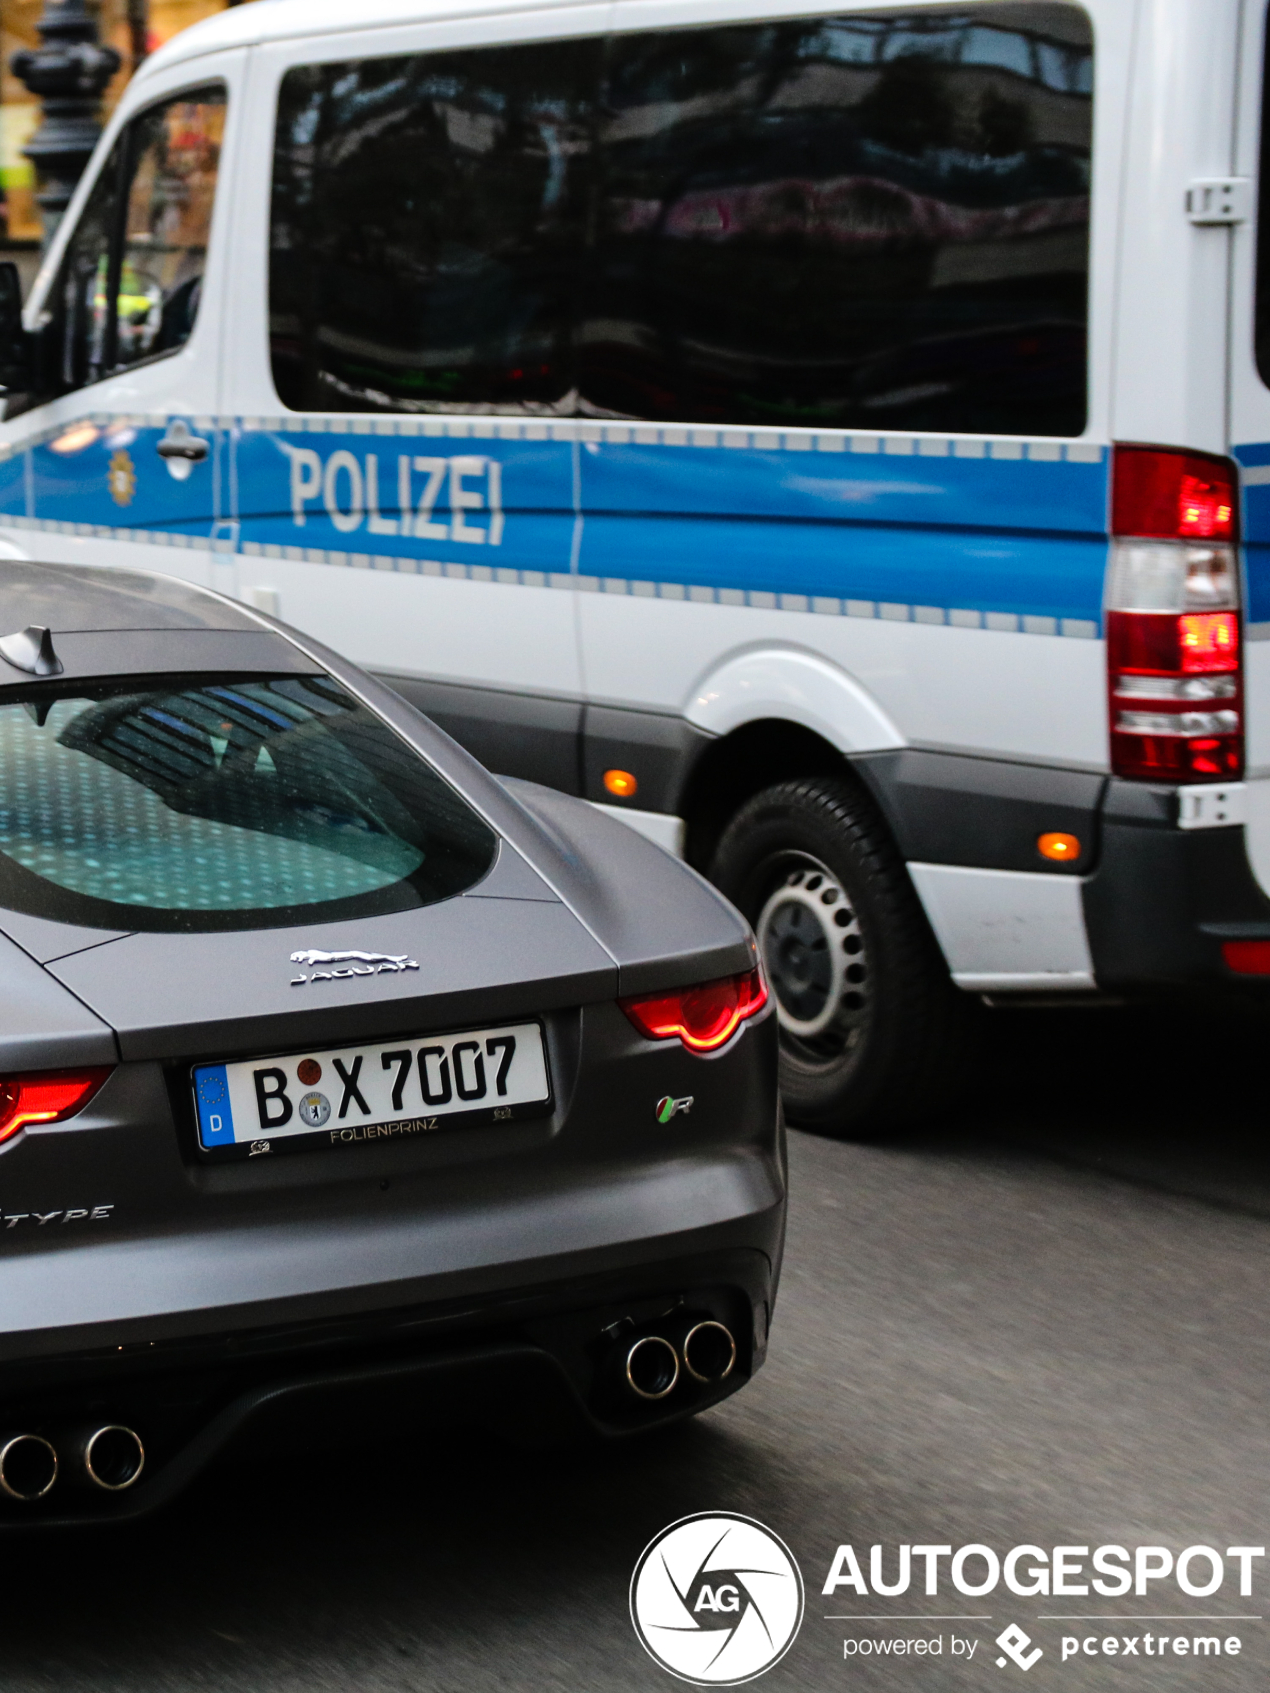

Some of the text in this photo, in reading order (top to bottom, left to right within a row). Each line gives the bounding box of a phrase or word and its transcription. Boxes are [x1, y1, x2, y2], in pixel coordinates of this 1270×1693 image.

[290, 447, 505, 546] POLIZEI
[290, 960, 420, 985] JAGUAR
[253, 1036, 516, 1129] B X 7007
[210, 1115, 223, 1132] D
[330, 1117, 439, 1143] FOLIENPRINZ
